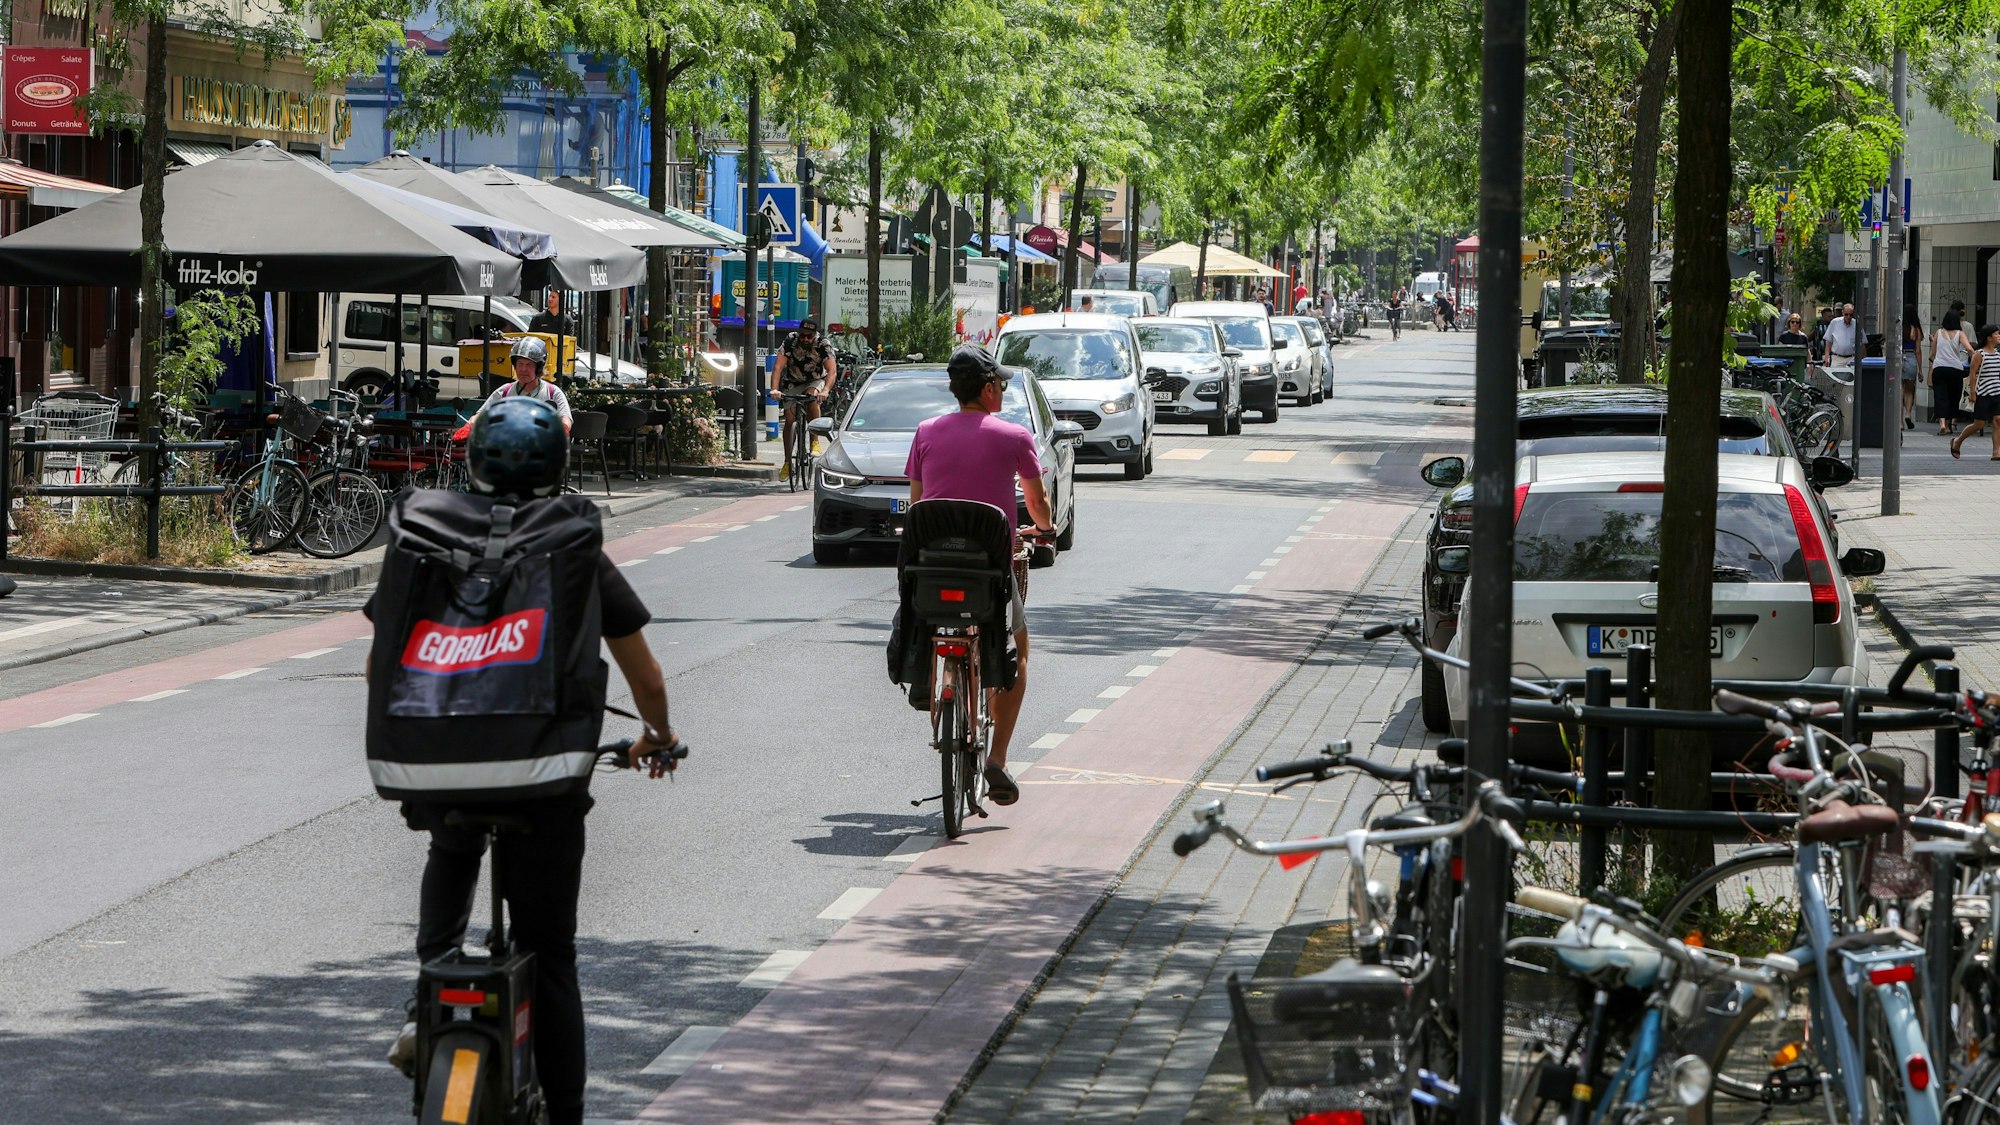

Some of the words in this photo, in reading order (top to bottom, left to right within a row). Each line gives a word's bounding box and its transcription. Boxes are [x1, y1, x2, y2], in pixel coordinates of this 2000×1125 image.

[11, 54, 36, 63] Crêpes
[61, 55, 82, 63] Salate
[183, 76, 222, 123] HAUS
[50, 120, 82, 128] Getränke
[418, 618, 529, 665] GORILLAS
[1602, 629, 1615, 649] K
